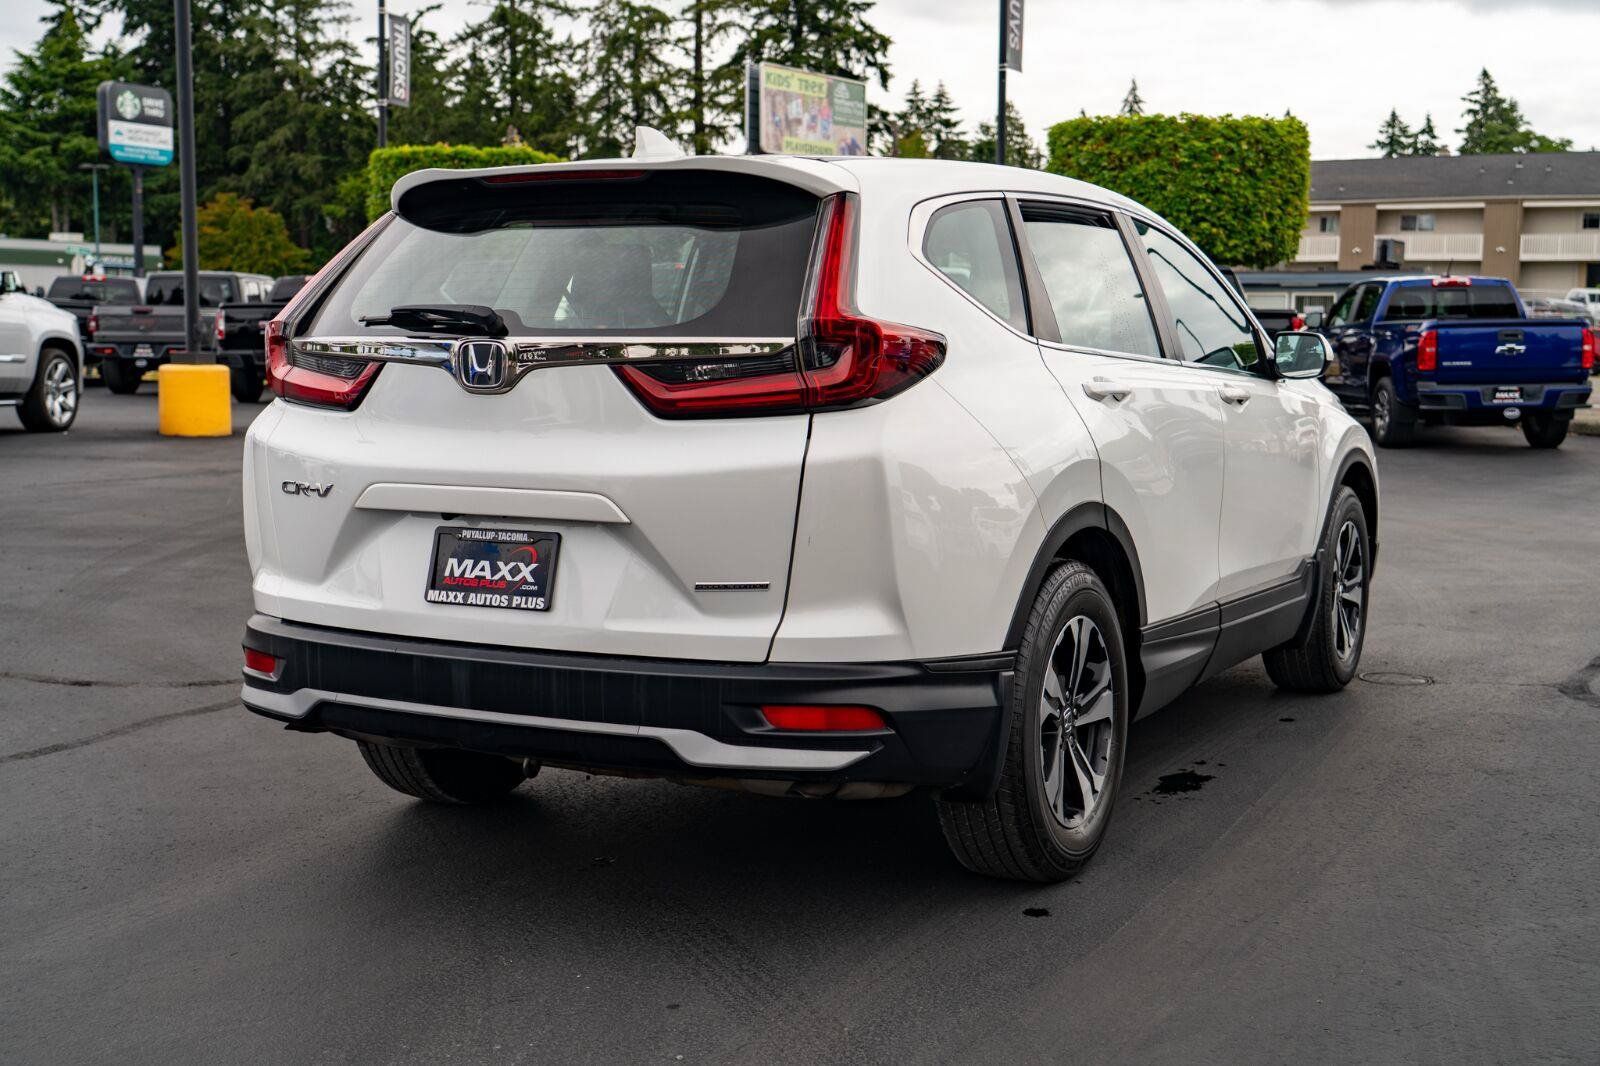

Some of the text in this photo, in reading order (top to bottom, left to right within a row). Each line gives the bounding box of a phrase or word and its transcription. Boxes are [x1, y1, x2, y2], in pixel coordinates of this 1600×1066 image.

[393, 22, 407, 100] TRUCKS
[281, 480, 334, 498] CR-V
[443, 557, 539, 583] MAXX
[443, 577, 508, 589] AUTOS PLUS
[427, 589, 545, 610] MAXX AUTOS PLUS
